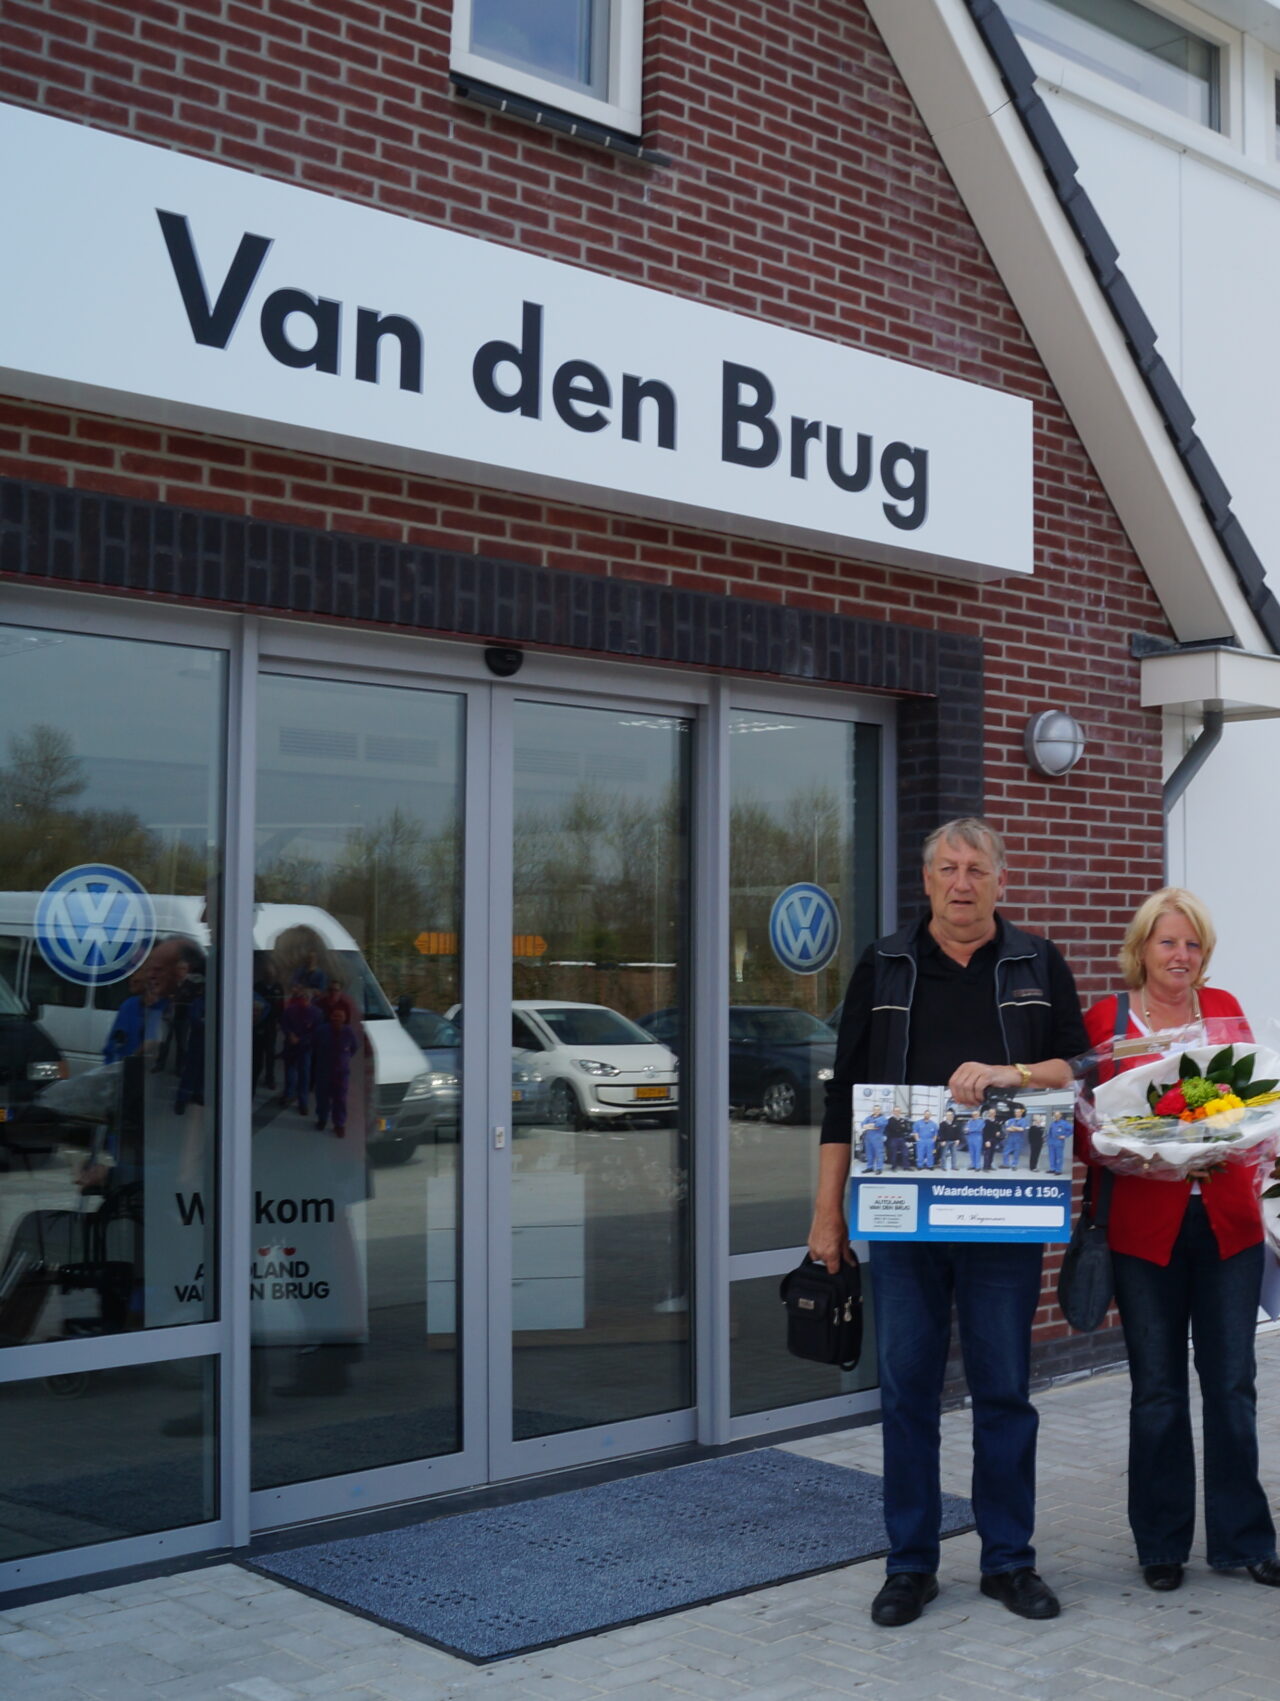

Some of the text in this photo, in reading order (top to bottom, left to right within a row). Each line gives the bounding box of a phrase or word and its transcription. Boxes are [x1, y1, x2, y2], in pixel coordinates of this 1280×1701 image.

[155, 207, 930, 532] Van den Brug
[932, 1185, 1013, 1199] Waardecheque
[1025, 1186, 1034, 1198] €
[175, 1190, 335, 1226] Wkom
[272, 1281, 330, 1300] BRUG
